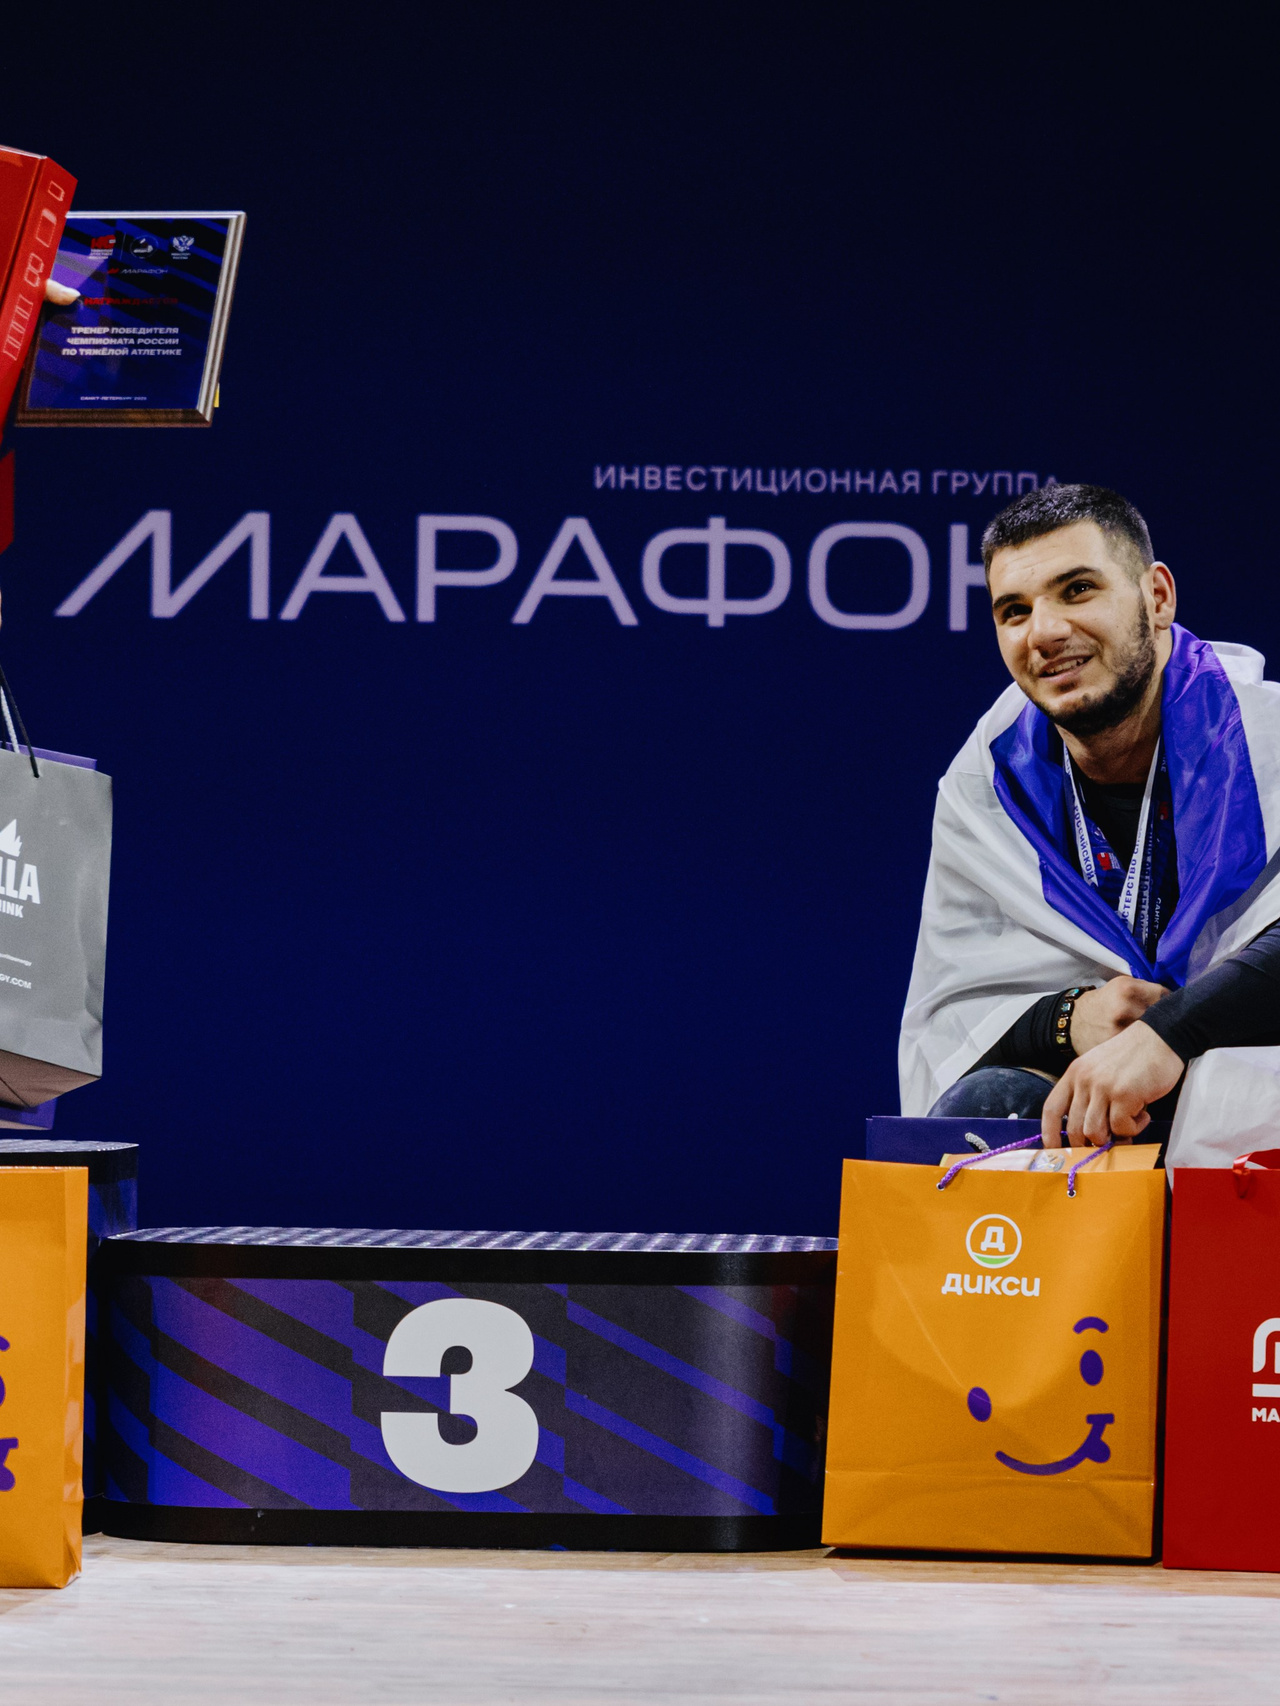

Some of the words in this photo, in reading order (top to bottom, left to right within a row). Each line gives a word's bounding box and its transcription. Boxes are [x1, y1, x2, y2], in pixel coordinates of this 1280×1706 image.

[71, 326, 109, 335] ТРЕНЕР
[111, 327, 179, 335] ПОБЕДИТЕЛЯ
[67, 337, 135, 345] ЧЕМПИОНАТА
[62, 348, 78, 356] ПО
[131, 348, 182, 356] АТЛЕТИКЕ
[597, 467, 920, 495] ИНВЕСТИЦИОННАЯ
[382, 1300, 539, 1493] 3
